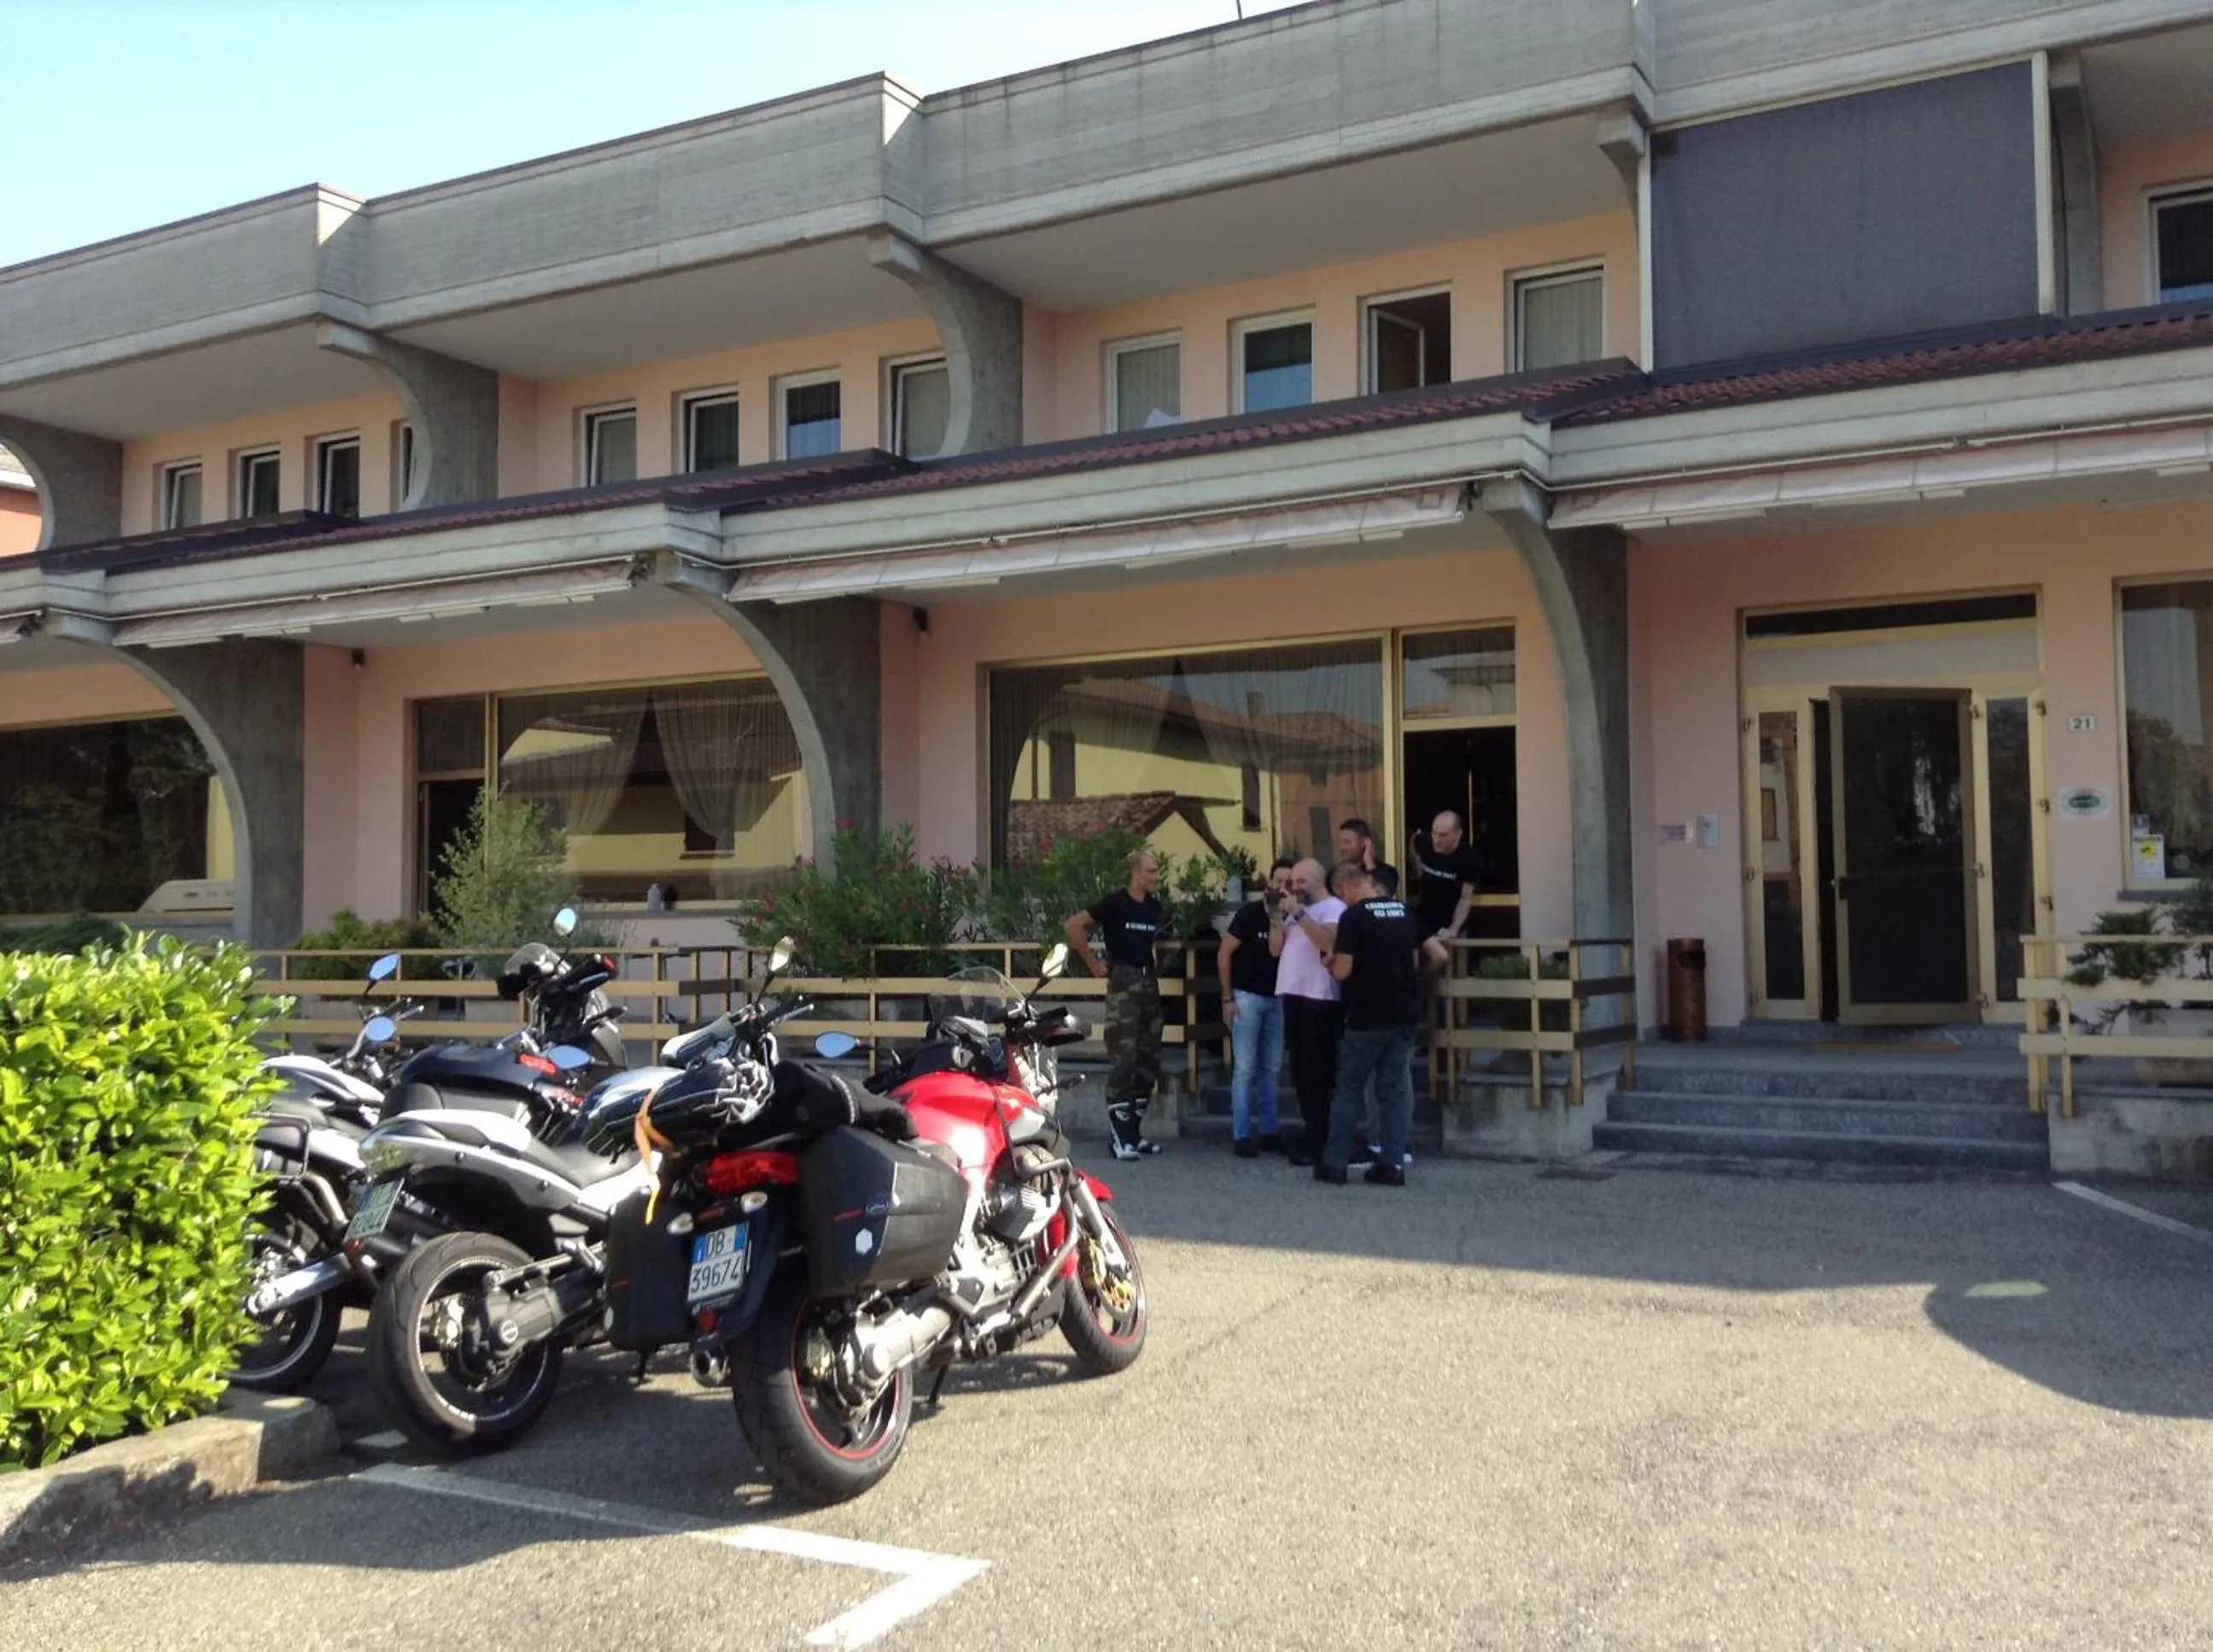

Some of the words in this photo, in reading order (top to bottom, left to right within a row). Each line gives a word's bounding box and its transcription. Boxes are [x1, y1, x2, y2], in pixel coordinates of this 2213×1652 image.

[2072, 717, 2090, 729] 21
[705, 1231, 726, 1258] DB
[690, 1255, 742, 1293] 39674
